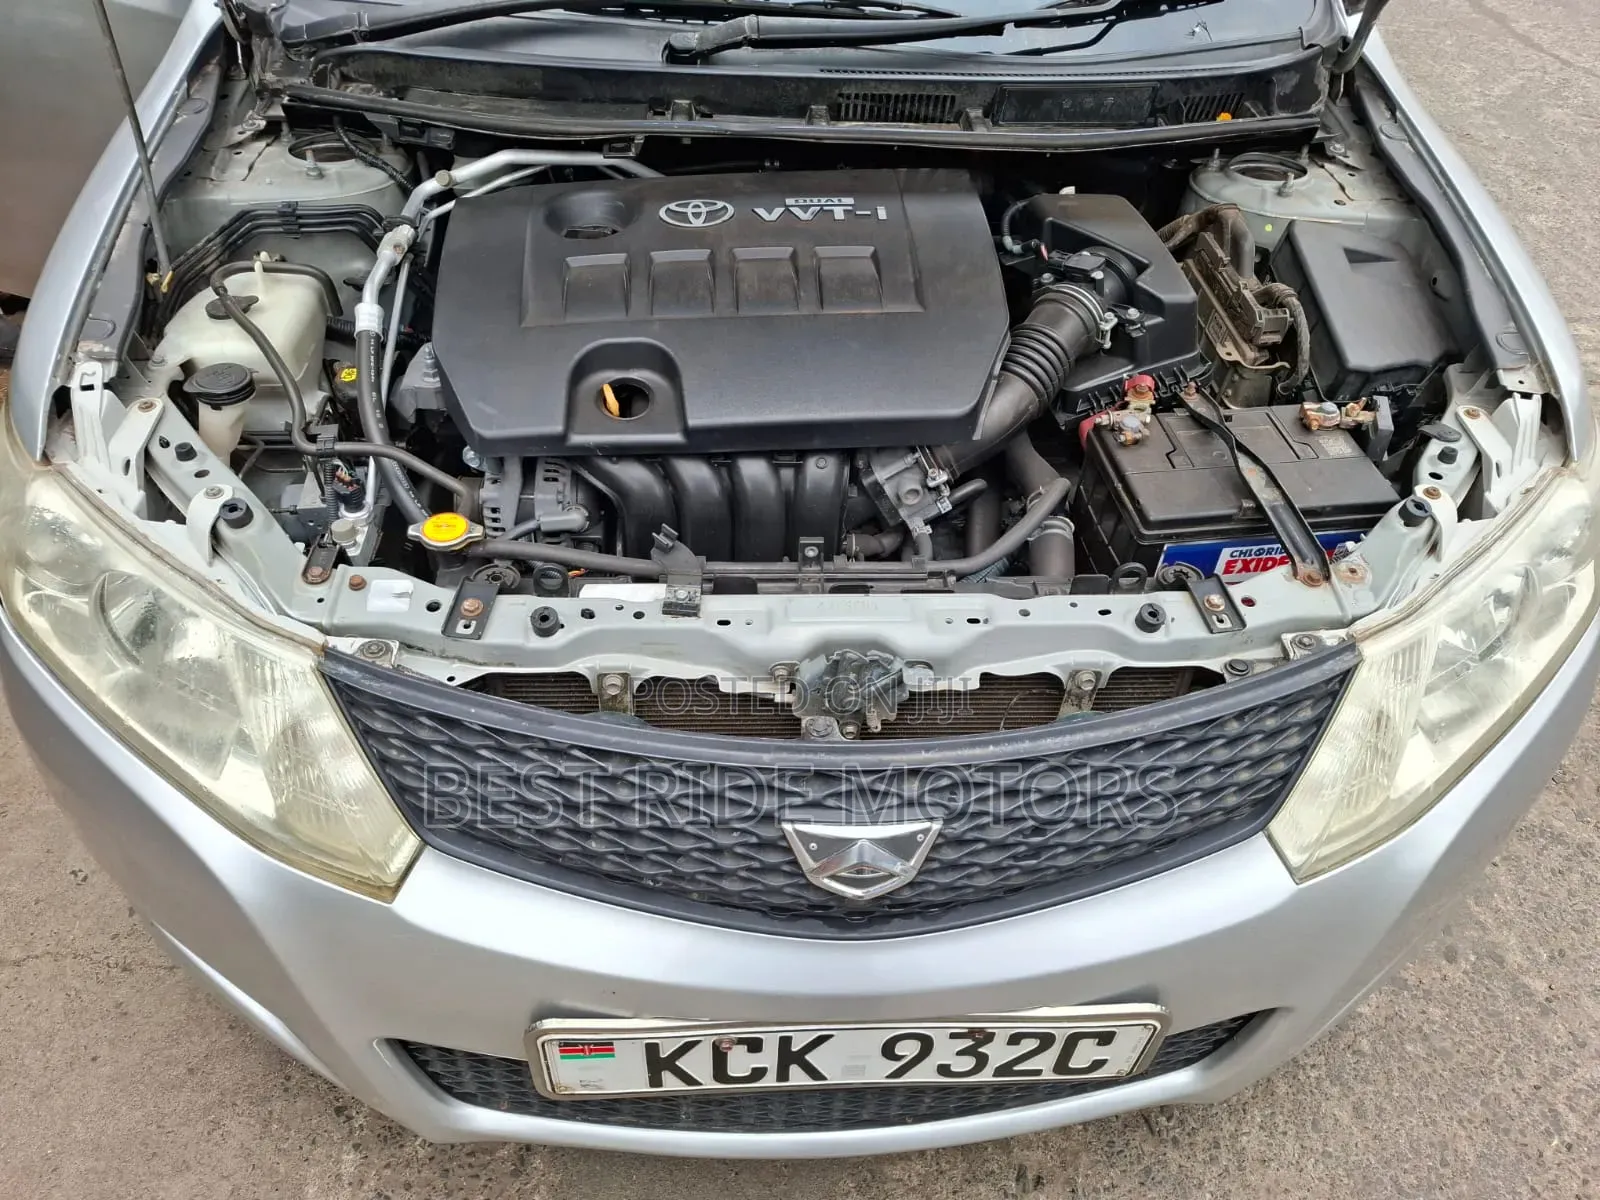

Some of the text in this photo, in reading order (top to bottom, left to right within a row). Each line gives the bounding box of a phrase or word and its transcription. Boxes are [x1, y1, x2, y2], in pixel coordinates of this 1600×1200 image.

[1222, 555, 1291, 575] EXIDE
[644, 1033, 835, 1088] KCK
[881, 1029, 1118, 1079] 932C
